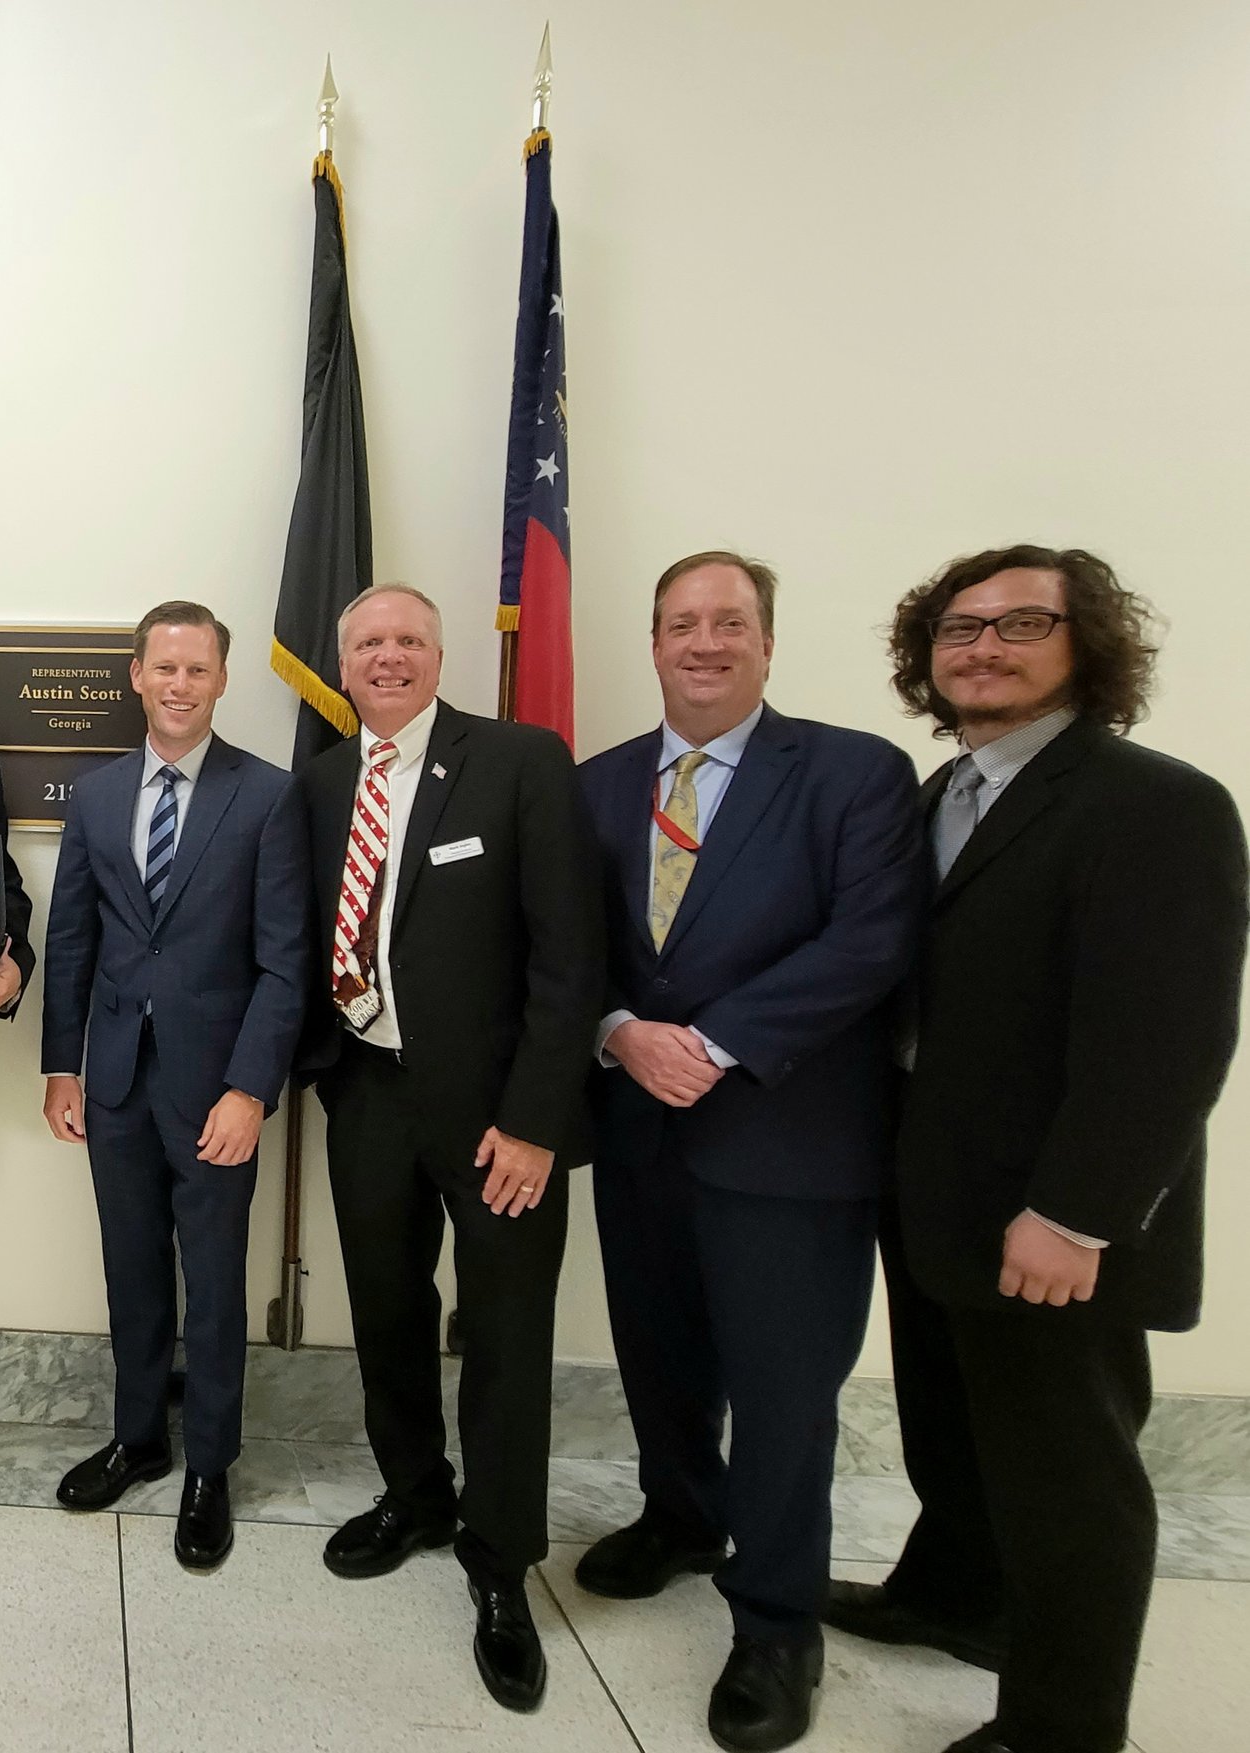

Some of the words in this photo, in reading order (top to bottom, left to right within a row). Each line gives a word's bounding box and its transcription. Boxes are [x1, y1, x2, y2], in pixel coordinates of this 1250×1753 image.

[31, 668, 111, 679] REPRESENTATIVE
[18, 684, 74, 700] Austin
[79, 685, 123, 701] Scott
[48, 718, 92, 731] Georgia
[43, 783, 74, 801] 21
